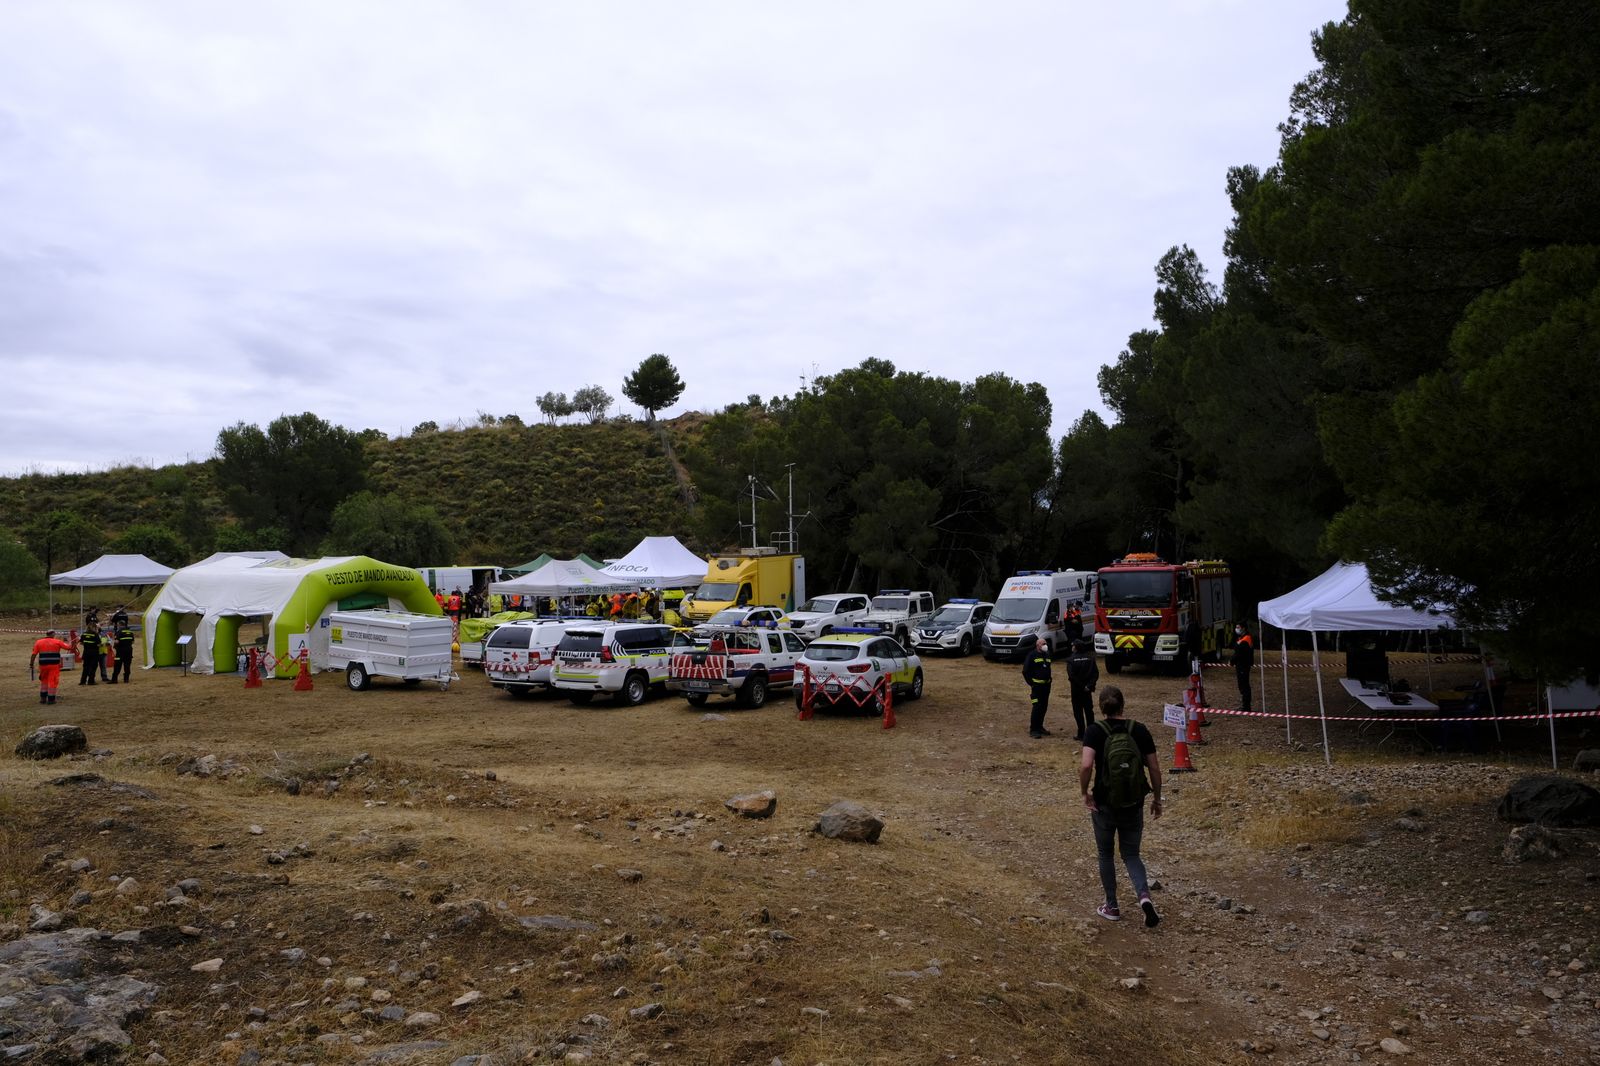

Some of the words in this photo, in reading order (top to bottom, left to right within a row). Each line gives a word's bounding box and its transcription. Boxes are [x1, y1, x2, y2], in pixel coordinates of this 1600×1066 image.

[607, 565, 649, 573] INFOCA
[325, 571, 354, 585] PUESTO
[354, 570, 363, 583] DE
[363, 569, 386, 582] MANDO
[386, 569, 415, 582] AVANZADO
